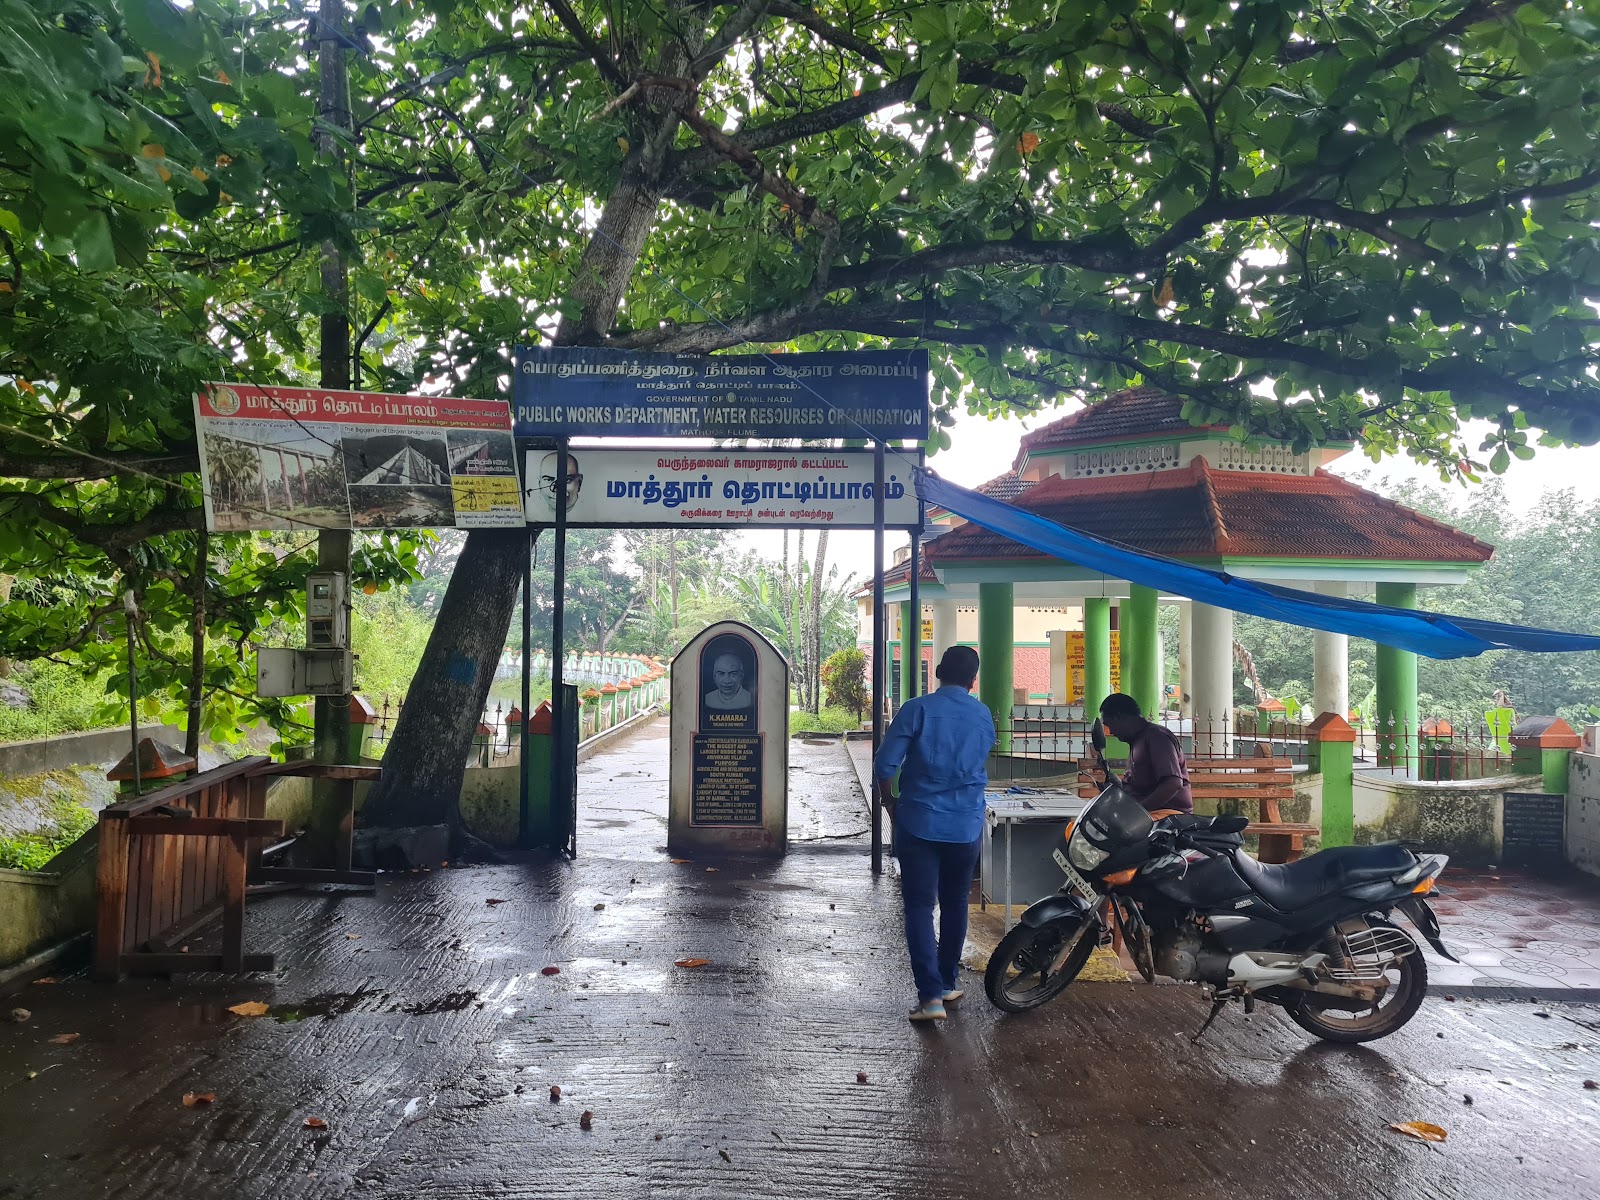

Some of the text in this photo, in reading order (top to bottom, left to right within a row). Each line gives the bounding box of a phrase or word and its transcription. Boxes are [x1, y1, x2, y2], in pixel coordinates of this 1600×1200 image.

[705, 360, 767, 377] நீர்வள
[773, 364, 834, 378] ஆதார
[839, 361, 917, 379] அமைப்பு
[637, 380, 691, 390] மாத்தூர்
[246, 390, 318, 415] மாத்தூர்
[646, 395, 709, 403] GOVERNMENT
[711, 395, 724, 403] OF
[518, 406, 563, 423] PUBLIC
[566, 407, 612, 424] WORKS
[615, 407, 701, 427] DEPARTMENT,
[703, 407, 746, 424] WATER
[750, 407, 824, 425] RESOURSES
[657, 456, 849, 471] பெருந்தலைவர் காமராஜரால் கட்டப்பட்ட
[607, 474, 905, 508] மாத்தூர் தொட்டிப்பாலம்
[680, 507, 723, 518] அருவிக்கரை
[757, 508, 786, 519] அன்புடன்
[790, 508, 834, 521] வரவேற்கிறது
